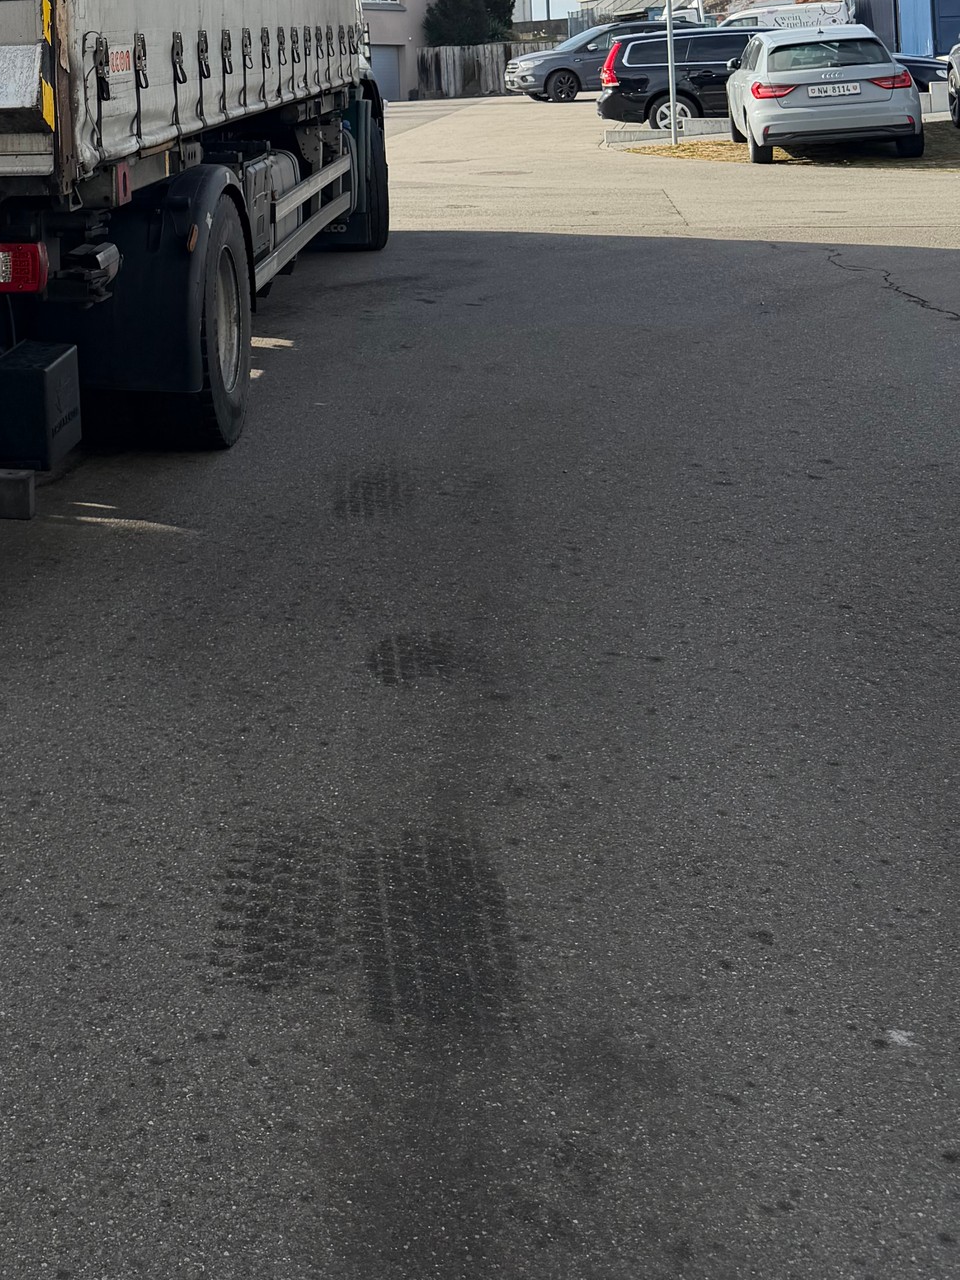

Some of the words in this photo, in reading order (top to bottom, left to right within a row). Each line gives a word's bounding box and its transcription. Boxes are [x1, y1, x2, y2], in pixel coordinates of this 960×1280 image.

[817, 86, 828, 95] NW
[831, 84, 851, 94] 8114
[323, 224, 347, 233] ECO
